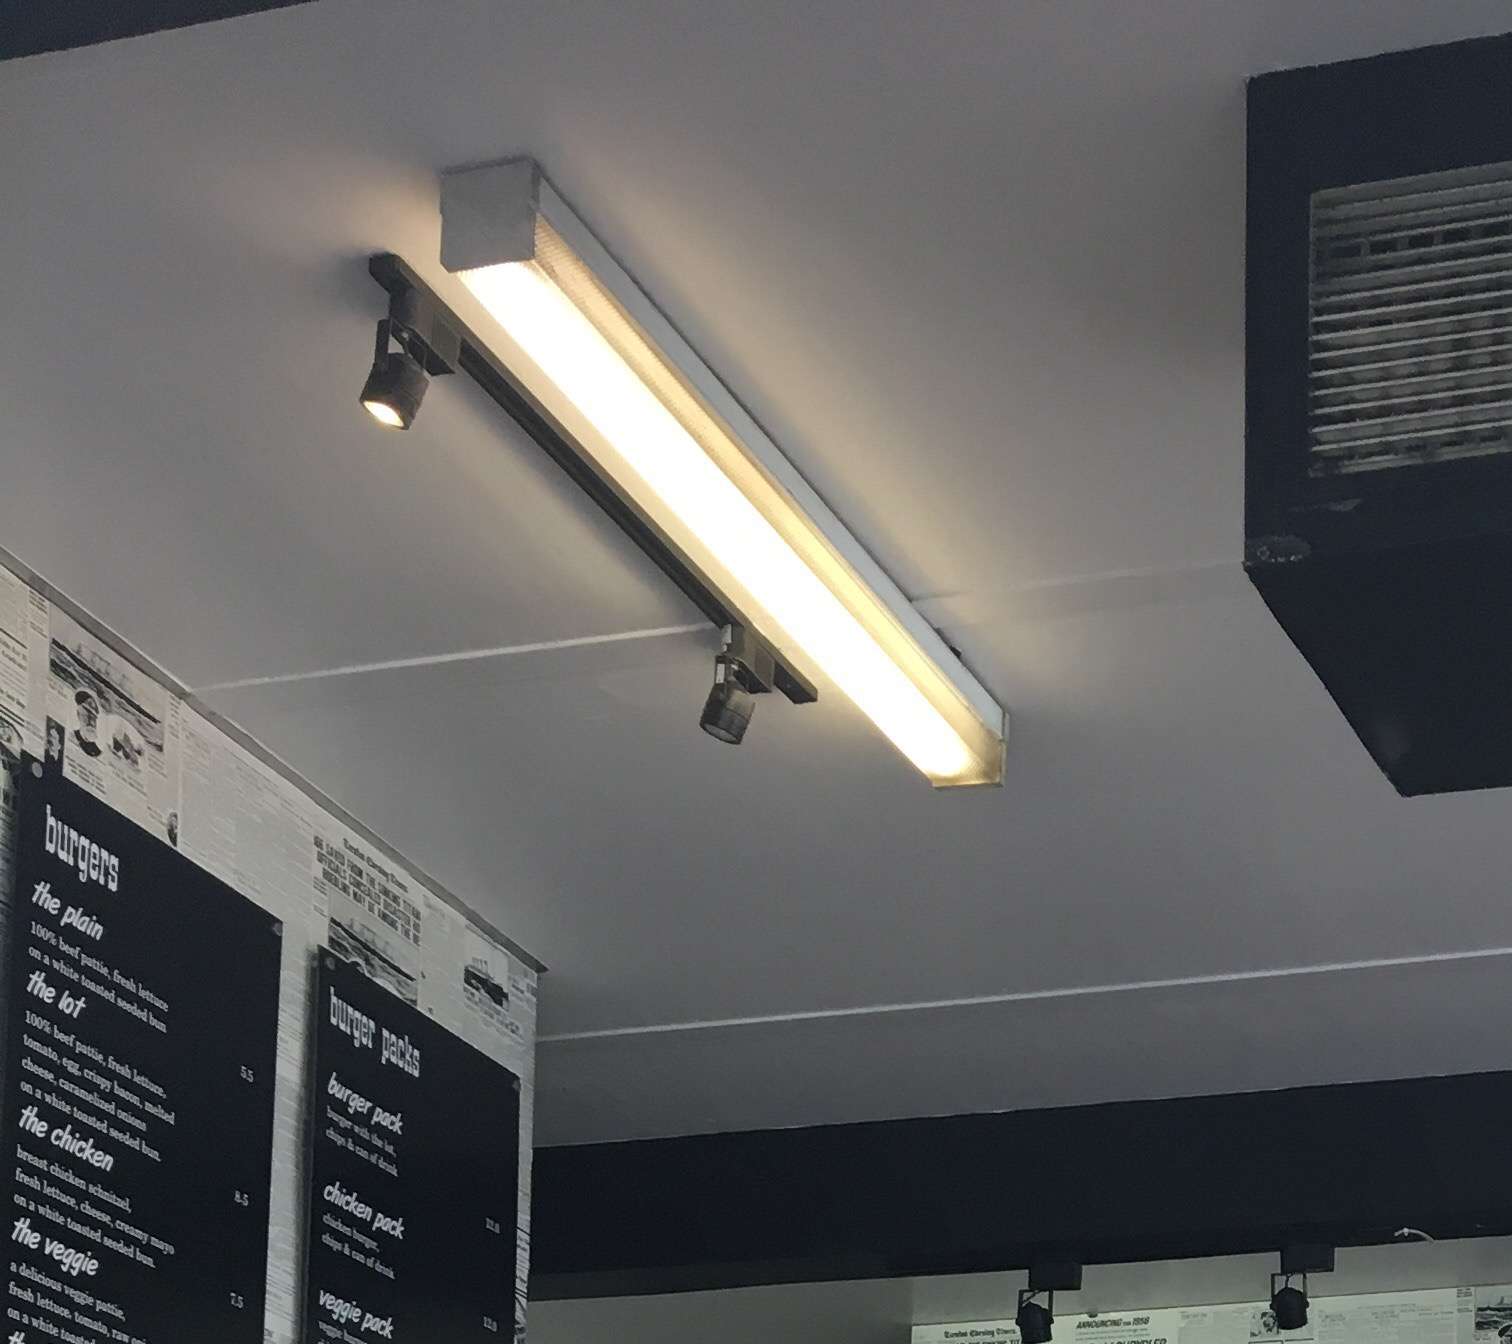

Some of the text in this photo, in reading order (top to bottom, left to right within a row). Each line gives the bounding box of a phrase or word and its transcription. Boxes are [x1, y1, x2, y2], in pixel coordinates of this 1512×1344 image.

[45, 804, 120, 892] burgers
[31, 881, 104, 941] the plain
[30, 921, 136, 994] 100% beef fresh
[26, 970, 86, 1019] the lot
[329, 985, 420, 1078] burger packs
[327, 1071, 403, 1135] burger pack
[18, 1105, 114, 1172] the chicken
[323, 1181, 405, 1239] chicken pack
[11, 1217, 99, 1277] the veggie
[18, 1263, 63, 1292] delicious
[319, 1289, 394, 1339] veggie pack
